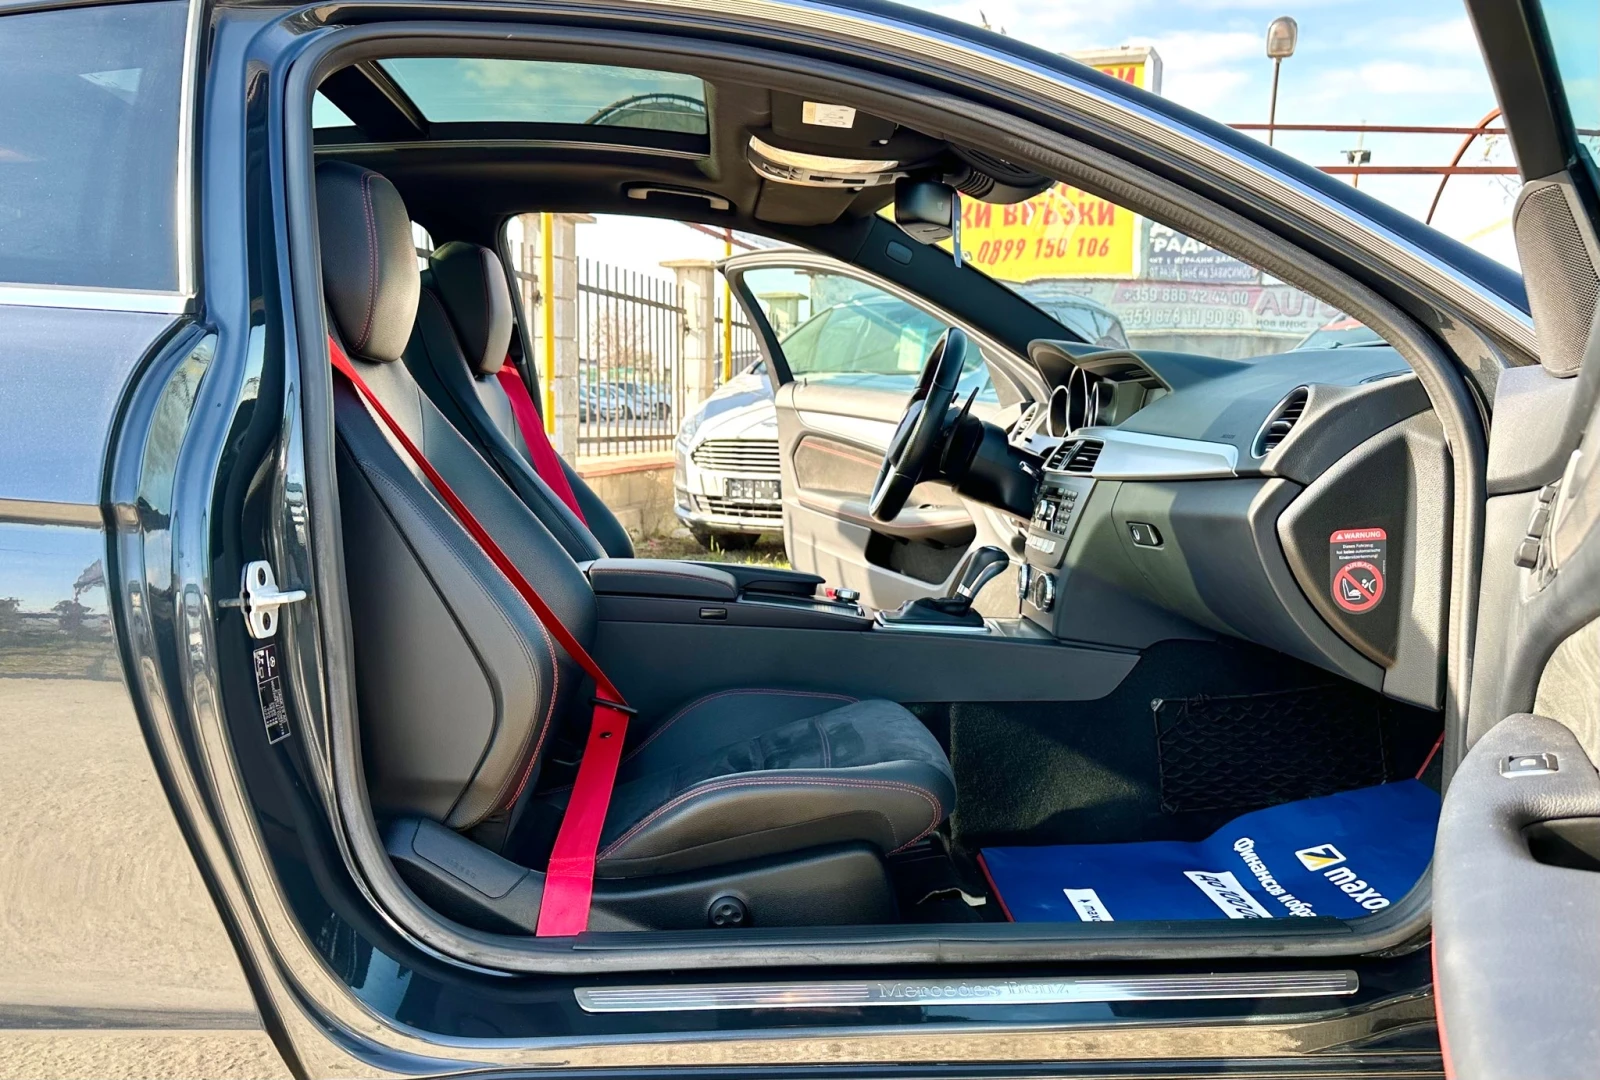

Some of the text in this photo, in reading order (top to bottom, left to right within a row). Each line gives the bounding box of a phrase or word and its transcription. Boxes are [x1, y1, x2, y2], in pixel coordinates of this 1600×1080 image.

[977, 237, 1110, 265] 0899 150 106
[1123, 287, 1248, 306] +359 886 42 44 00
[1186, 309, 1200, 324] 11
[1206, 309, 1223, 325] 90
[1227, 310, 1244, 326] 99
[1343, 531, 1381, 539] WARNUNG
[1233, 837, 1286, 896] Финансов
[1323, 866, 1390, 913] maxo
